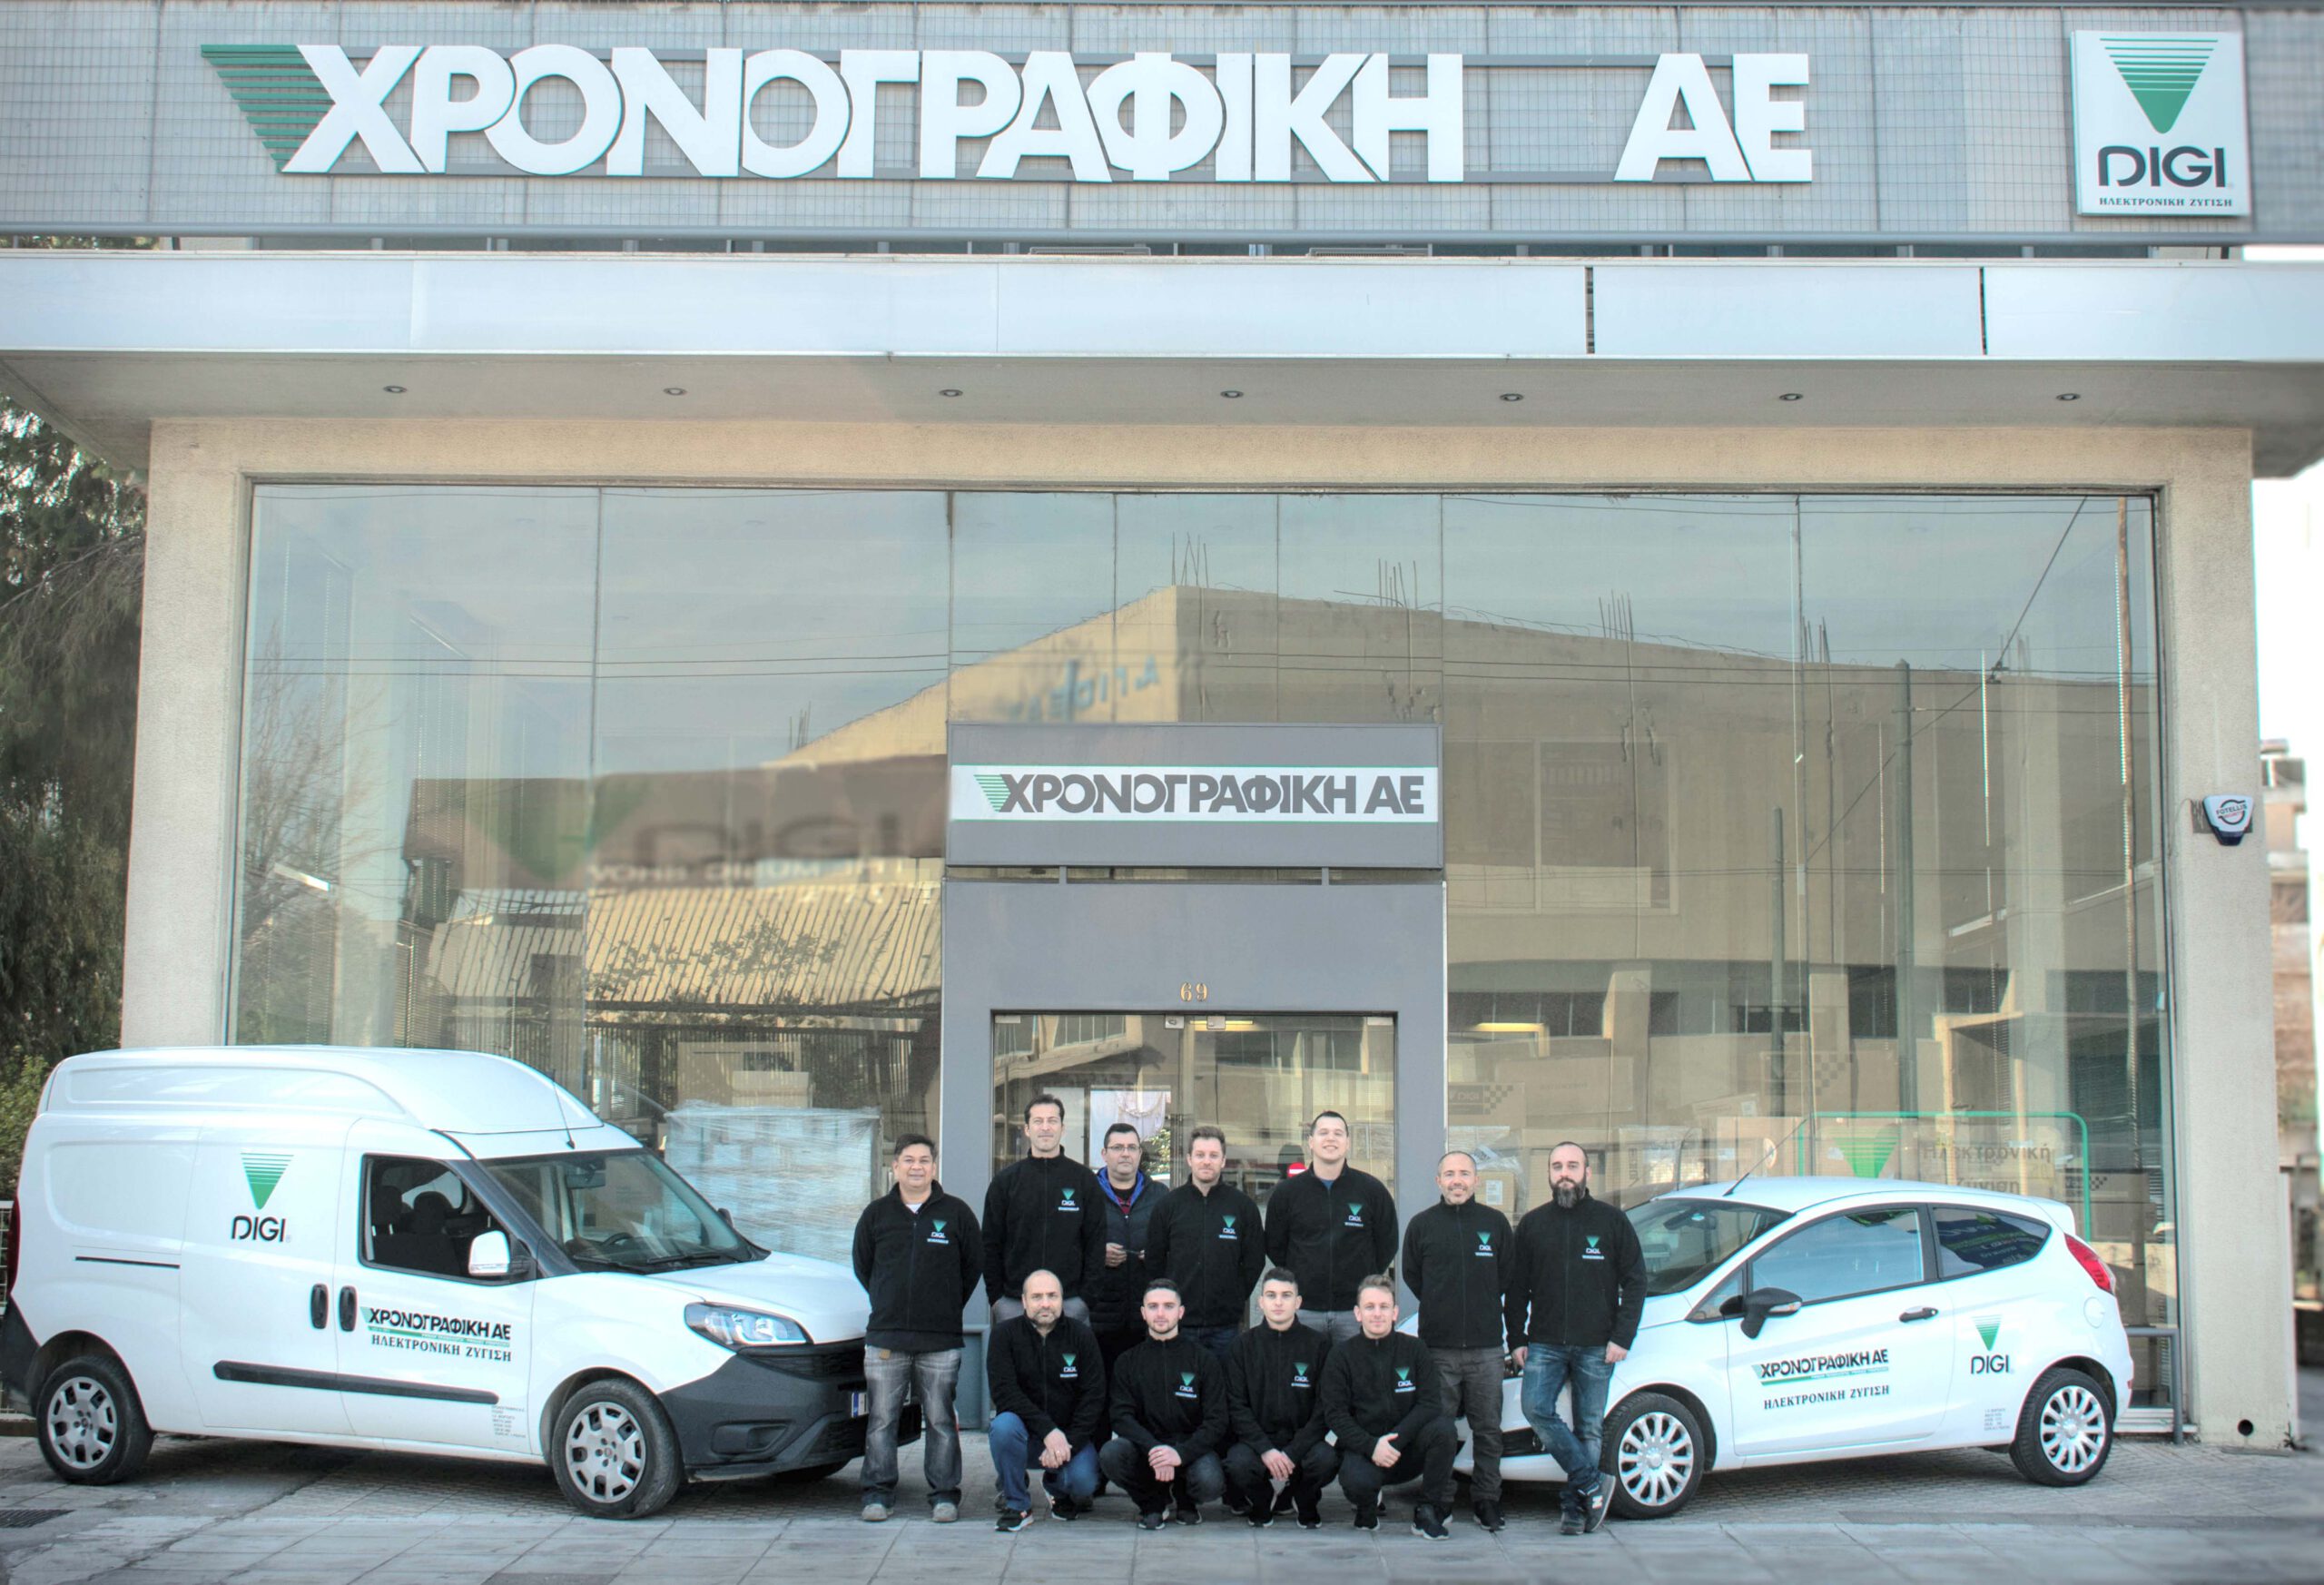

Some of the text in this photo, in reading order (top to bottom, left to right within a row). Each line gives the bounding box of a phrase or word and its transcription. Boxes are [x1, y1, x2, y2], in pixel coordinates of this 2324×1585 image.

[281, 44, 1813, 183] ΧΡΟΝΟΓΡΑΦΙΚΗ ΑΕ
[2098, 145, 2227, 187] DIGI
[2099, 197, 2232, 208] ΗΛΕΚΤΡΟΝΙΚΗ ΖΥΓΙΣΗ
[999, 773, 1424, 814] ΧΡΟΝΟΓΡΑΦΙΚΗ ΑΕ
[1180, 982, 1207, 1002] 69
[231, 1215, 286, 1242] DIGI
[369, 1307, 490, 1338] ΧΡΟΝΟΓΡΑΦΙΚΗ
[491, 1324, 512, 1341] ΑΕ
[371, 1334, 460, 1356] ΗΛΕΚΤΡΟΝΙΚΗ
[466, 1346, 512, 1362] ΖΥΓΙΣΗ
[1760, 1351, 1870, 1378] ΧΡΟΝΟΓΡΑΦΙΚΗ
[1872, 1348, 1889, 1363] ΑΕ
[1970, 1354, 2009, 1374] DIGI
[1763, 1384, 1889, 1410] ΗΛΕΚΤΡΟΝΙΚΗ ΖΥΓΙΣΗ
